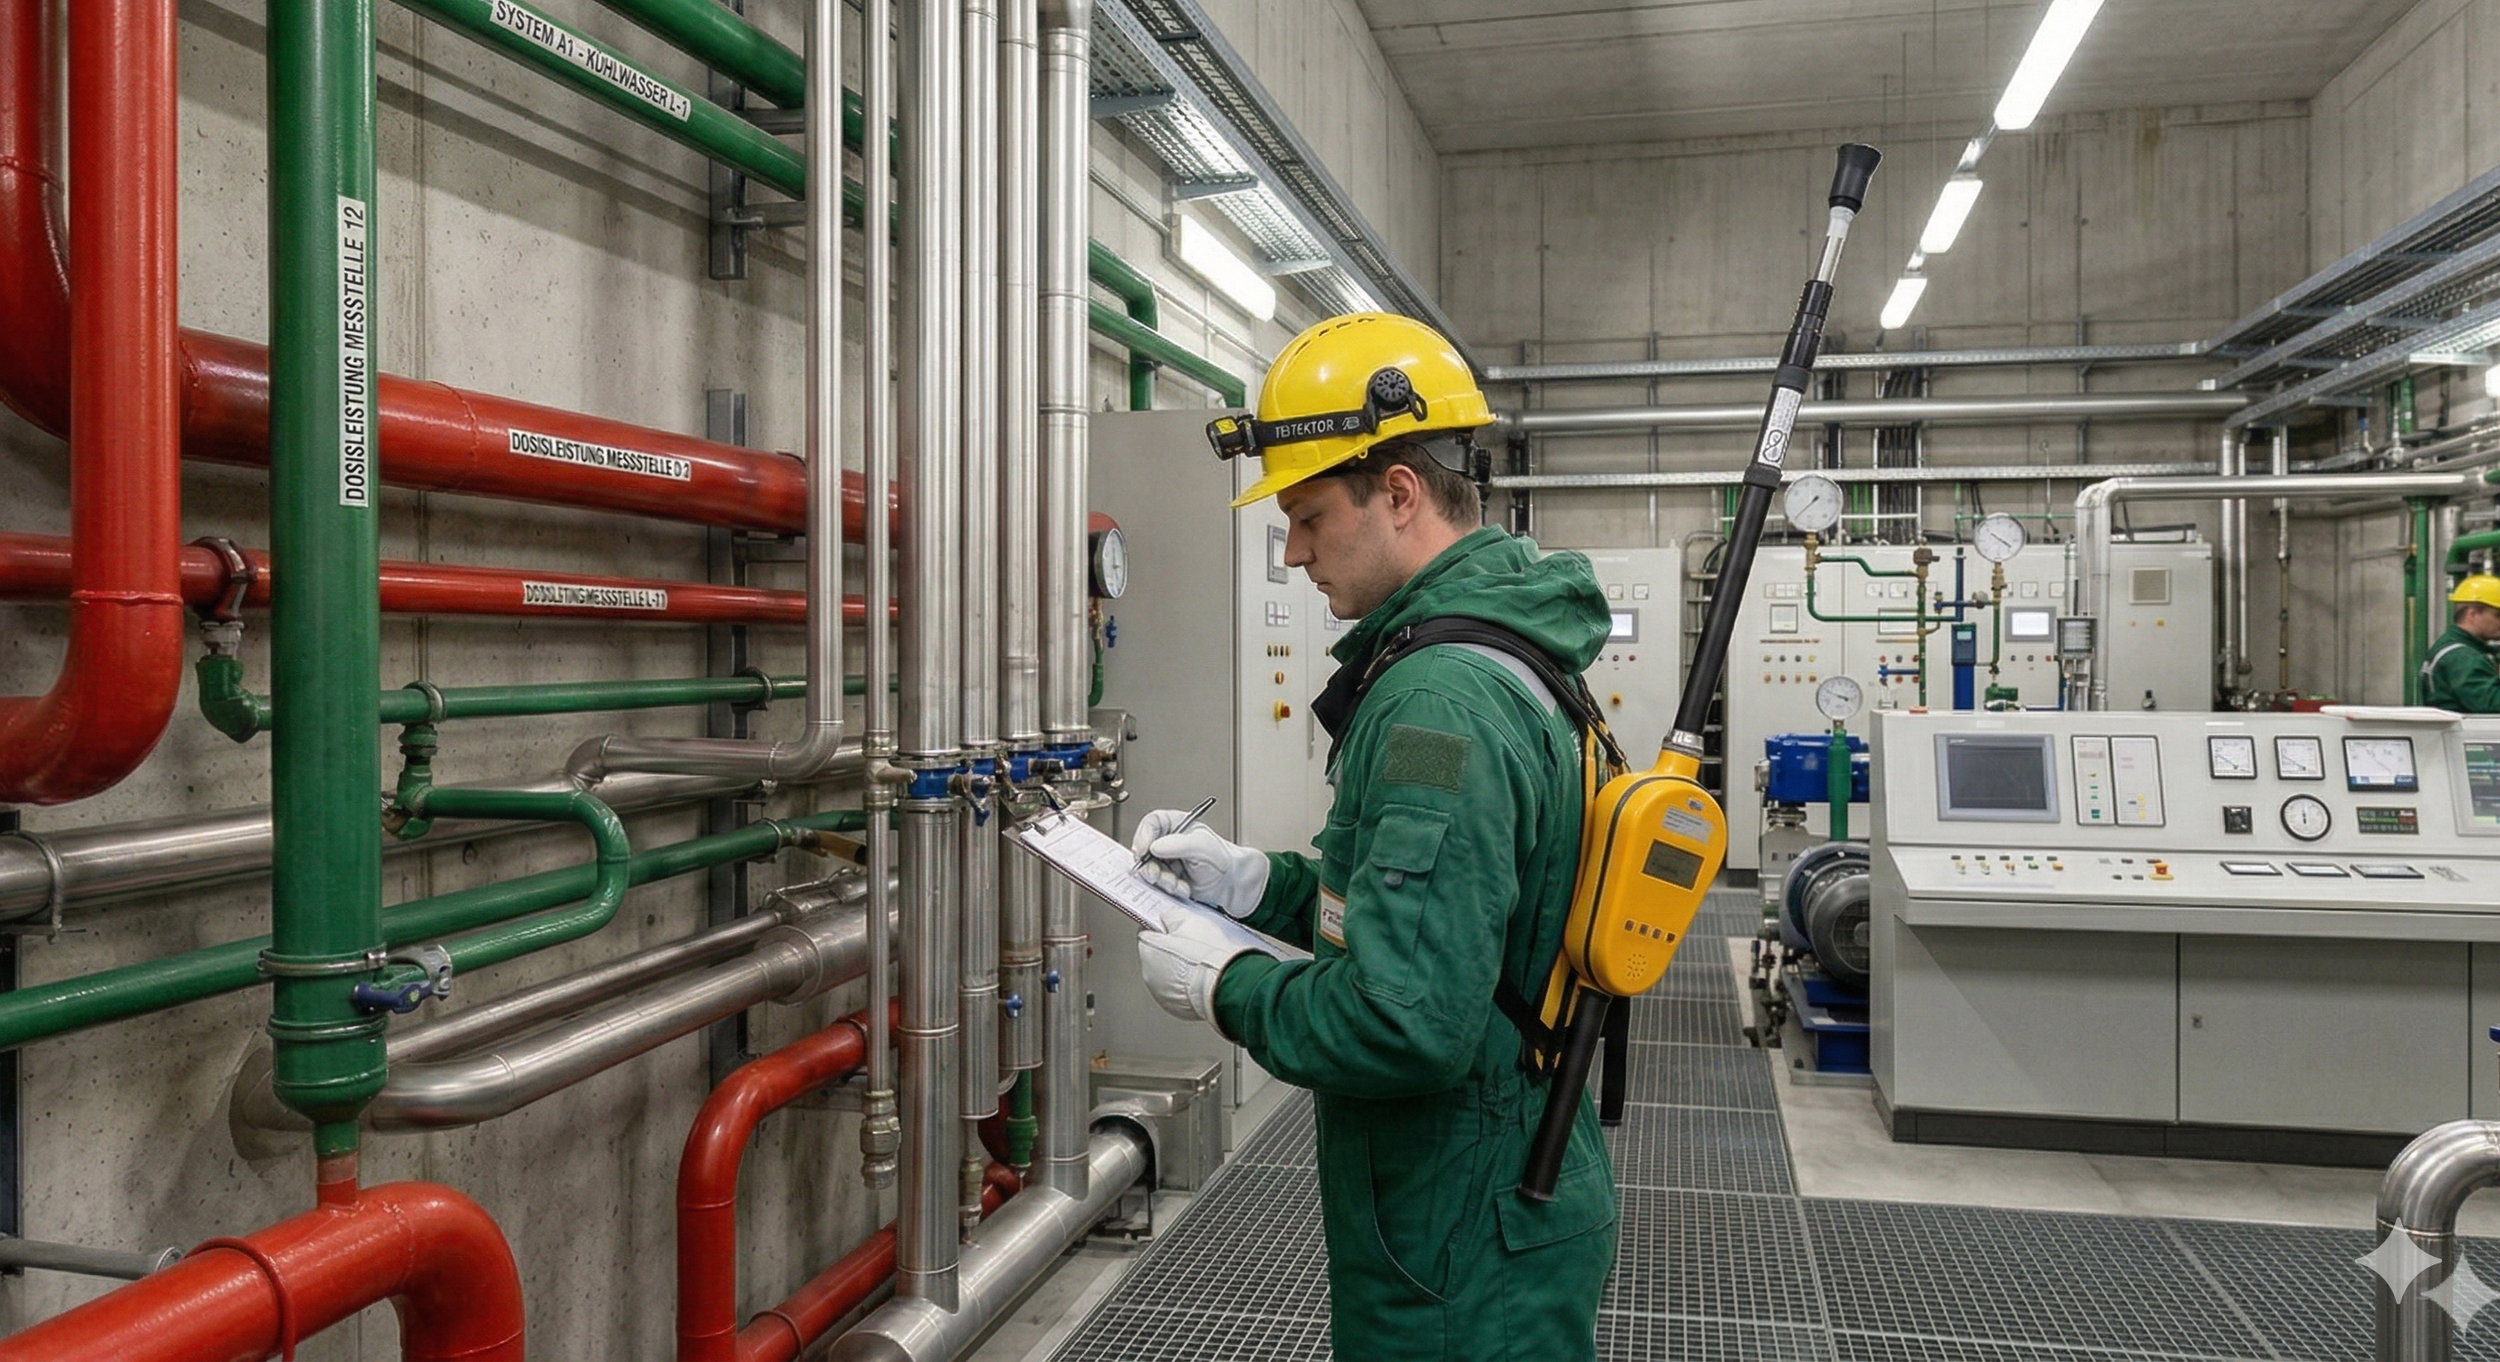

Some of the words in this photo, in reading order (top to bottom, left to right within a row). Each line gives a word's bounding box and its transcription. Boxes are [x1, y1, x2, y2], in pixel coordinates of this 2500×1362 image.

[496, 1, 554, 47] SYSTEM
[556, 33, 574, 57] A1
[585, 48, 668, 107] KÜHLWASSER
[669, 95, 688, 118] L-1
[343, 206, 364, 228] 12
[344, 237, 365, 352] MESSTELLE
[344, 356, 365, 500] DOSISLEISTUNG
